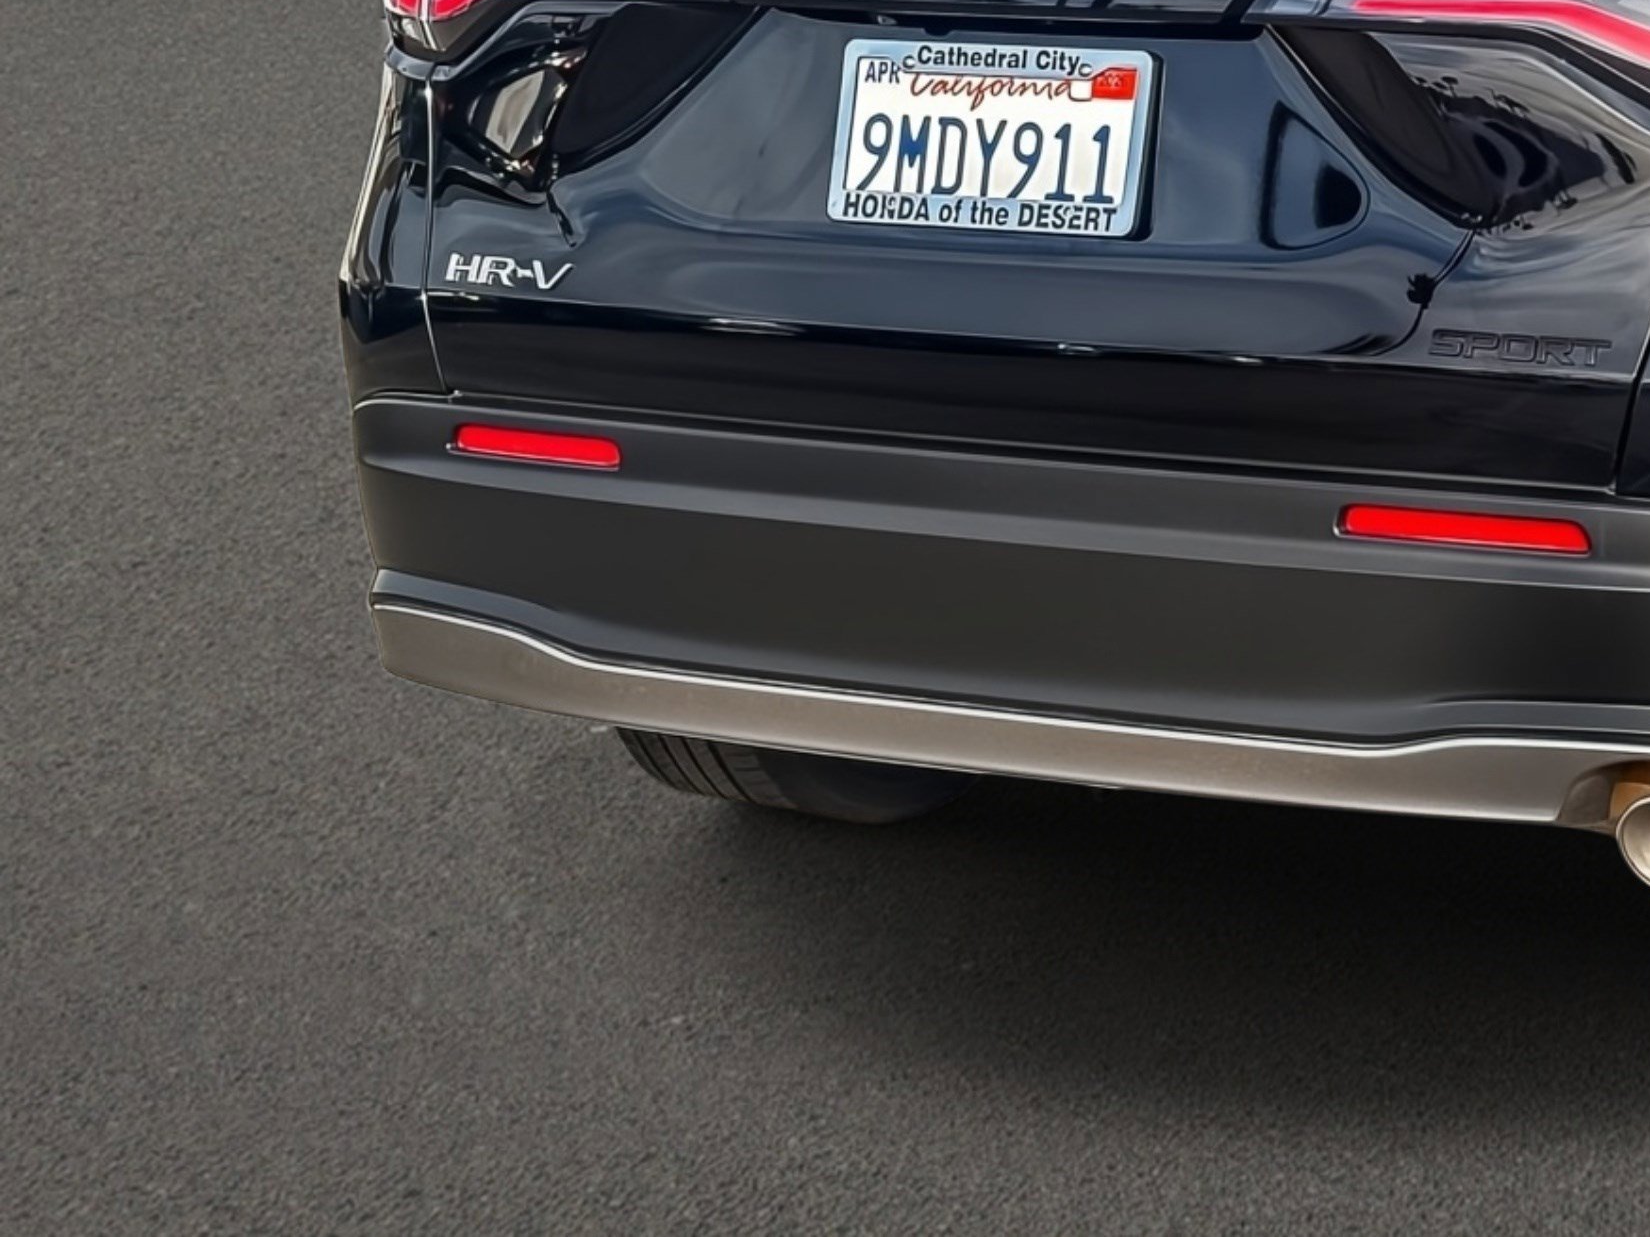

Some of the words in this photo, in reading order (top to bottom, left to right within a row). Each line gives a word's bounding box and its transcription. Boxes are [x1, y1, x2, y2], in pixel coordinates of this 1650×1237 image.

[864, 60, 901, 84] APR
[917, 44, 1029, 70] Cathedral
[1036, 49, 1081, 77] City
[855, 112, 1115, 204] 9MDY911
[842, 192, 931, 222] HONDA
[938, 197, 963, 224] of
[969, 201, 1009, 227] the
[1017, 203, 1118, 233] DESERT
[445, 252, 576, 290] HR-V
[1428, 328, 1613, 367] SPORT
